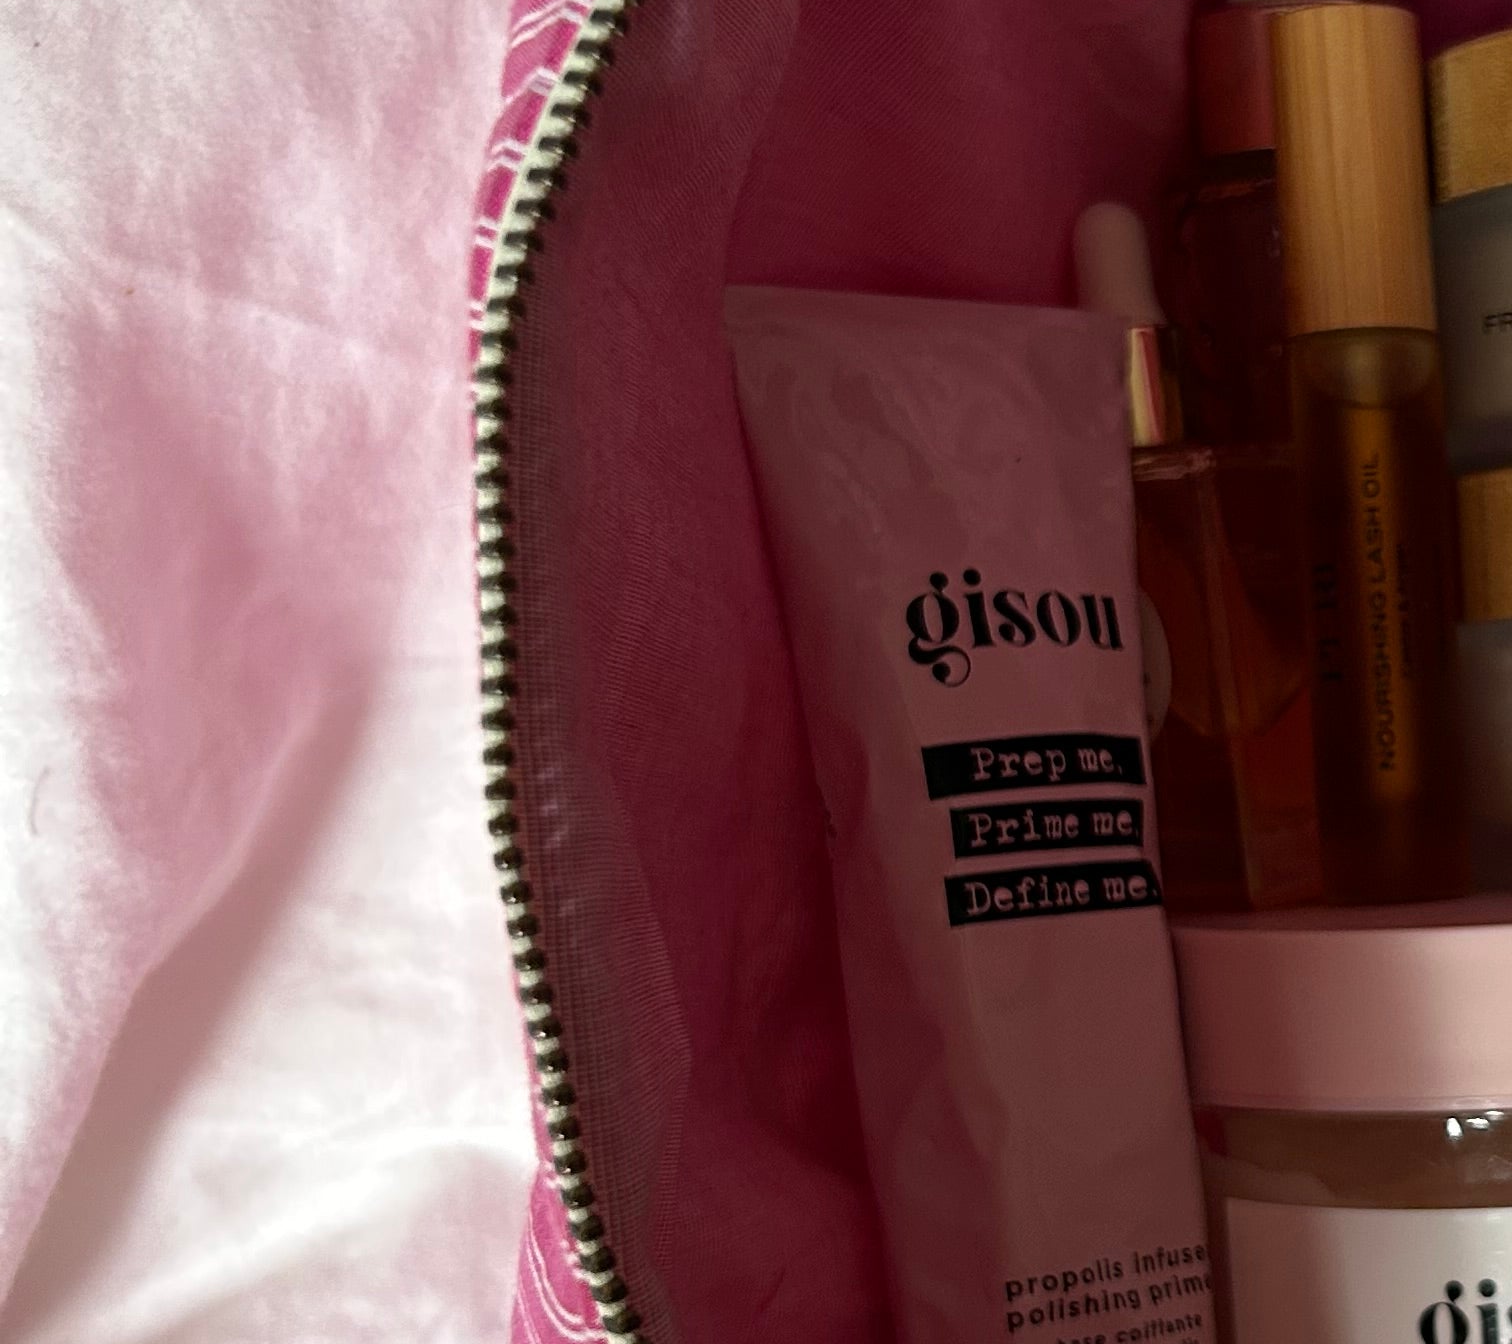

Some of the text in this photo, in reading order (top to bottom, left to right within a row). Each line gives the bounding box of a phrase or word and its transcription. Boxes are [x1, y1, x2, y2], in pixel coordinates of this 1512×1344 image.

[905, 568, 1124, 688] gisou
[1360, 453, 1395, 772] NOURISHING LASH OIL
[970, 747, 1069, 782] Prep
[968, 809, 1080, 847] Prime
[965, 874, 1091, 916] Define
[1005, 1258, 1124, 1302] propolis
[1006, 1286, 1141, 1334] polishing
